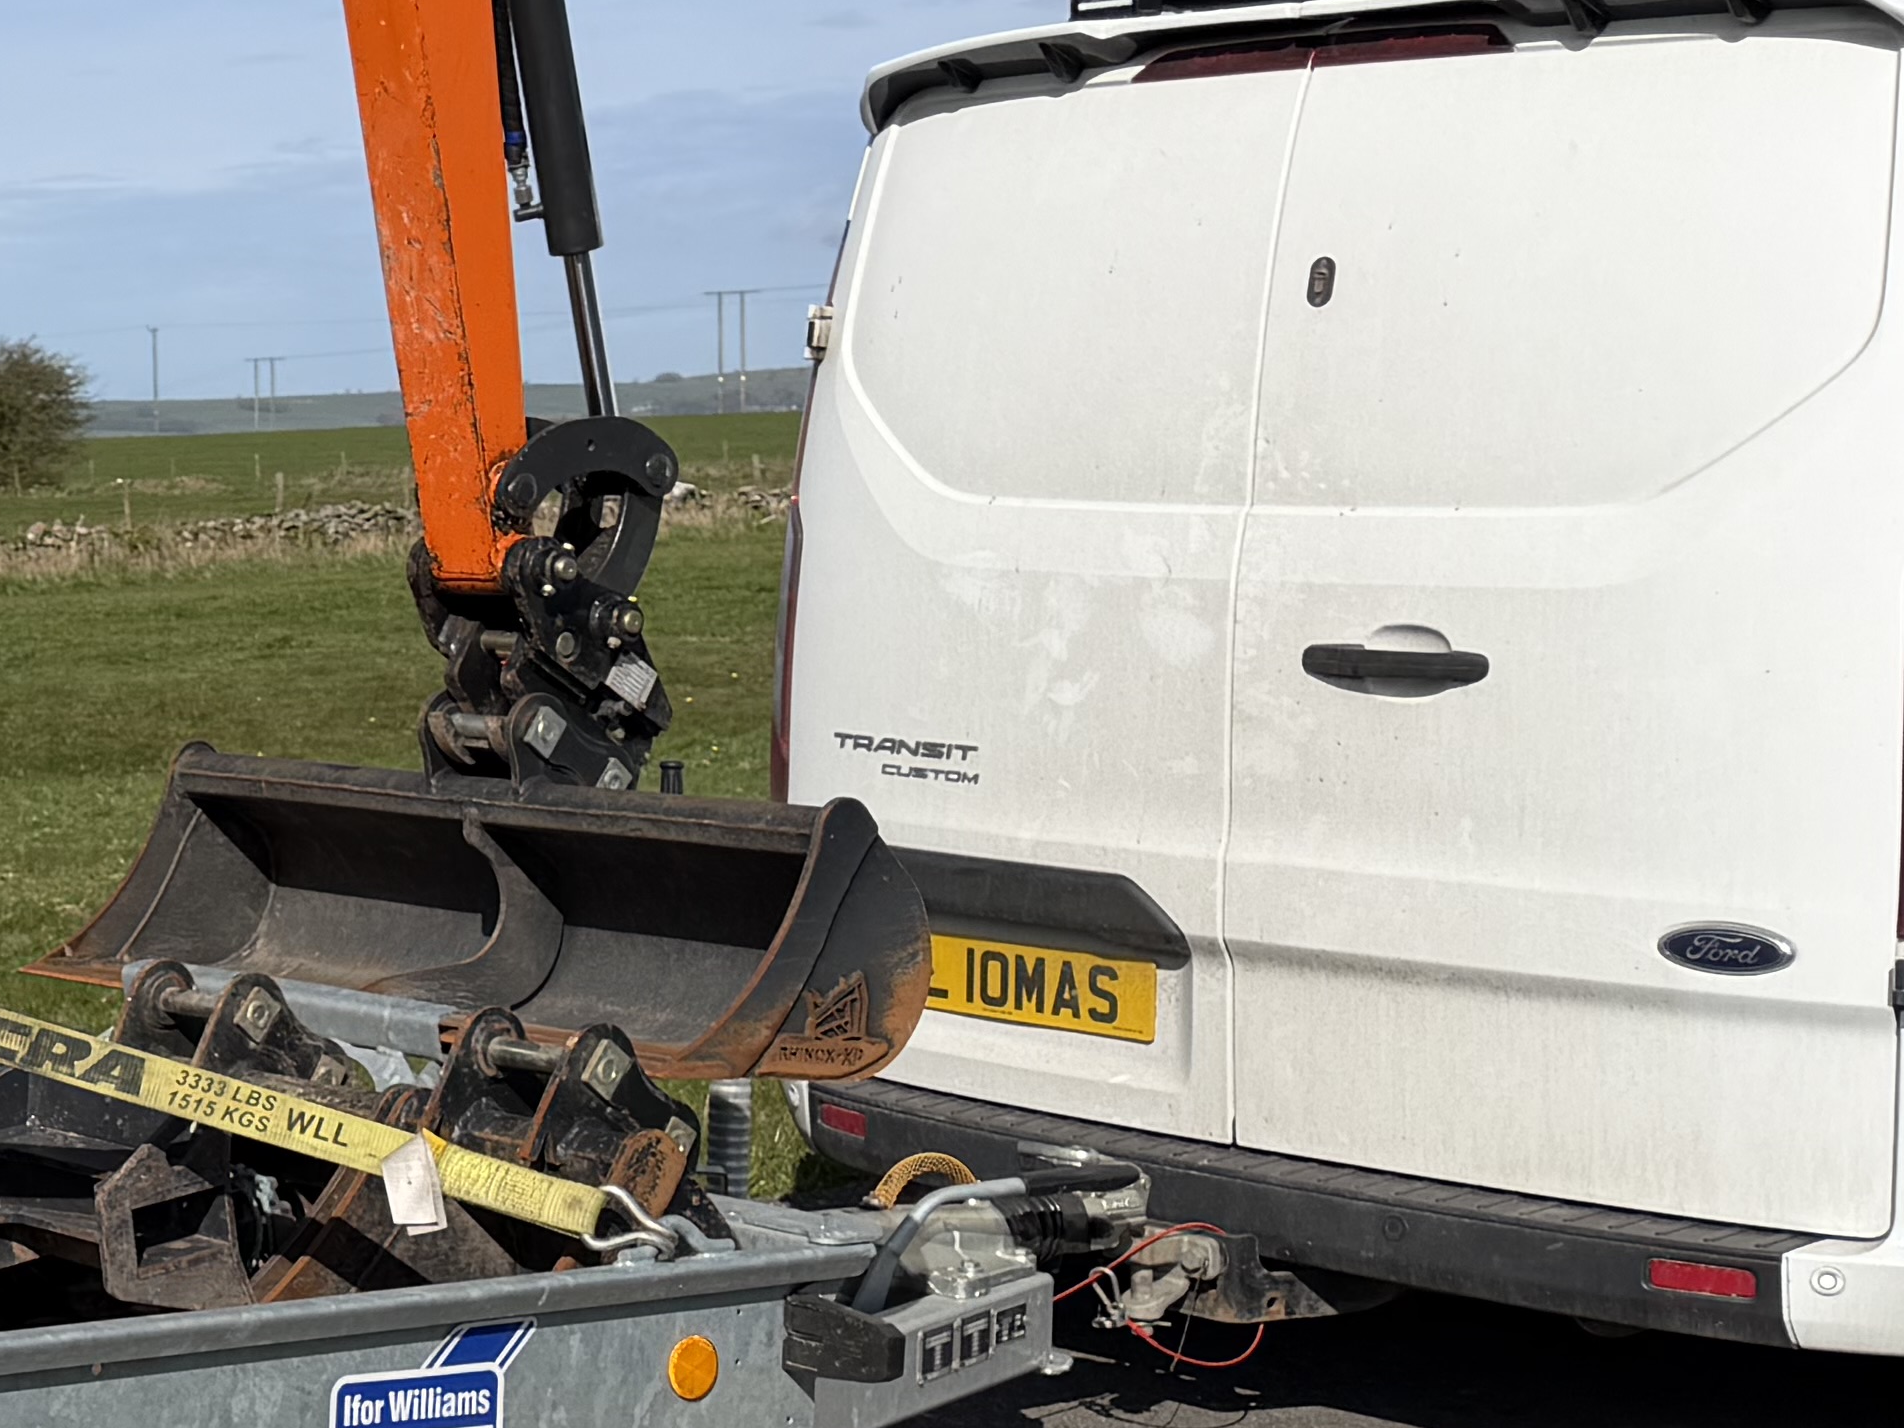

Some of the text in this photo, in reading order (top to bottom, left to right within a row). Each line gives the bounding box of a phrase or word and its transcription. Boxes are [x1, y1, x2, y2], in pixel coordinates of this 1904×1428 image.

[833, 731, 979, 761] TRANSIT
[880, 763, 980, 785] CUSTOM
[1686, 934, 1761, 964] Ford
[167, 1089, 271, 1133] 1515 KGS
[175, 1069, 278, 1112] 3333 LBS
[286, 1107, 350, 1148] WLL
[343, 1386, 491, 1427] Ifor Williams
